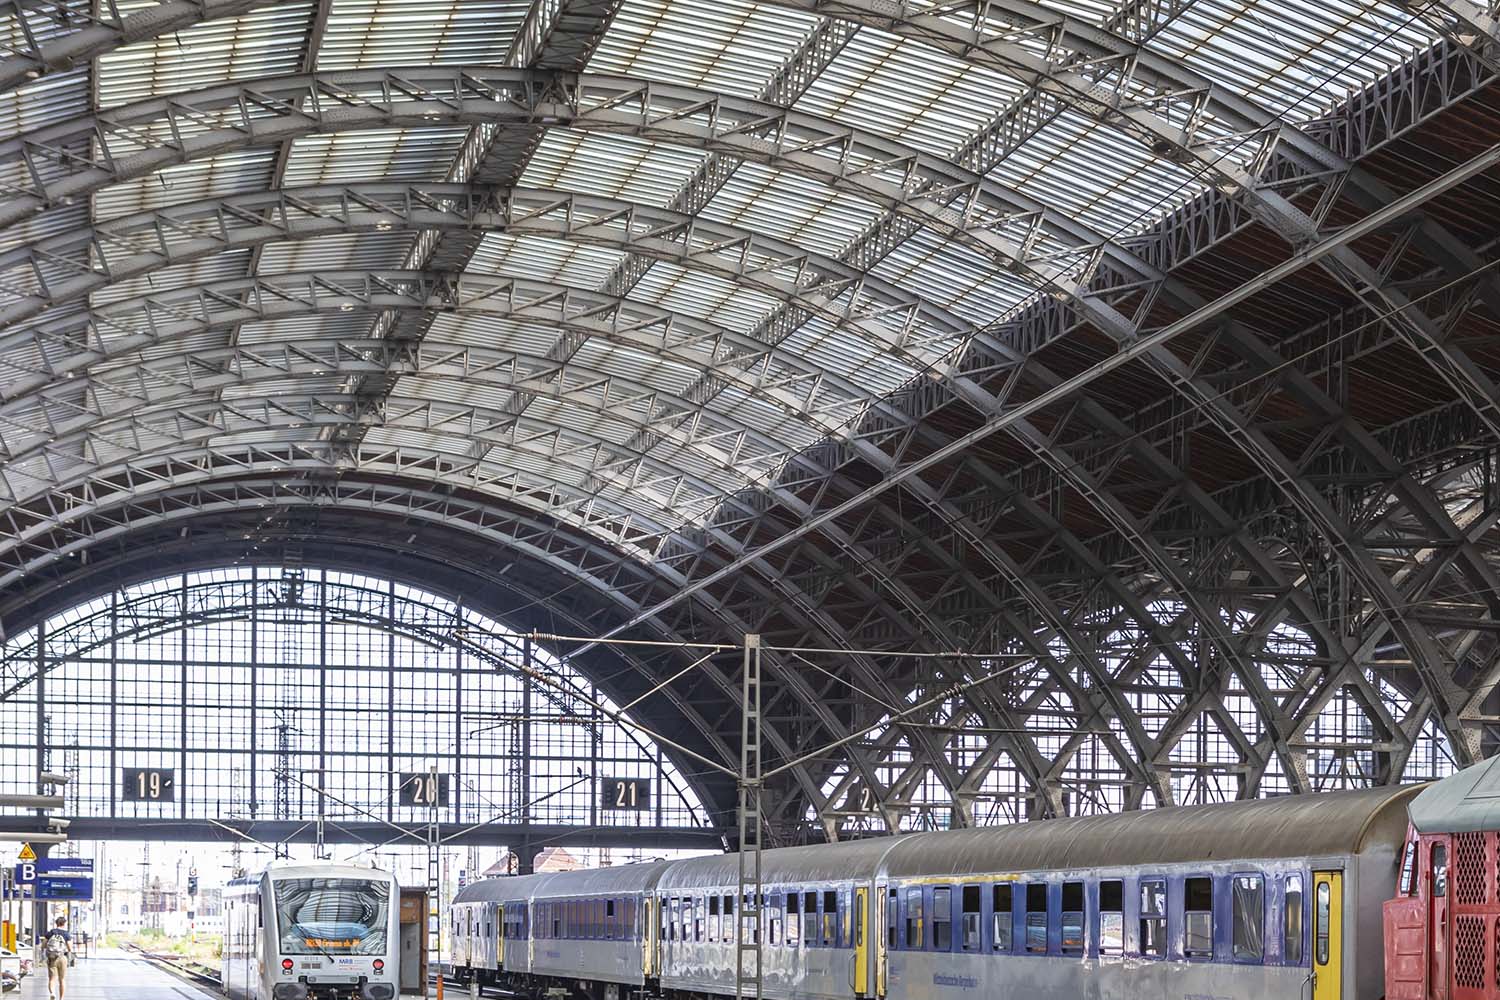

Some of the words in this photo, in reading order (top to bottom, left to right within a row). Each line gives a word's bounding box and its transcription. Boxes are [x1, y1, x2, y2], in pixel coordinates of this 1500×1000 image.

[138, 771, 160, 799] 19
[413, 777, 435, 803] 20
[616, 781, 636, 807] 21
[22, 864, 36, 880] B
